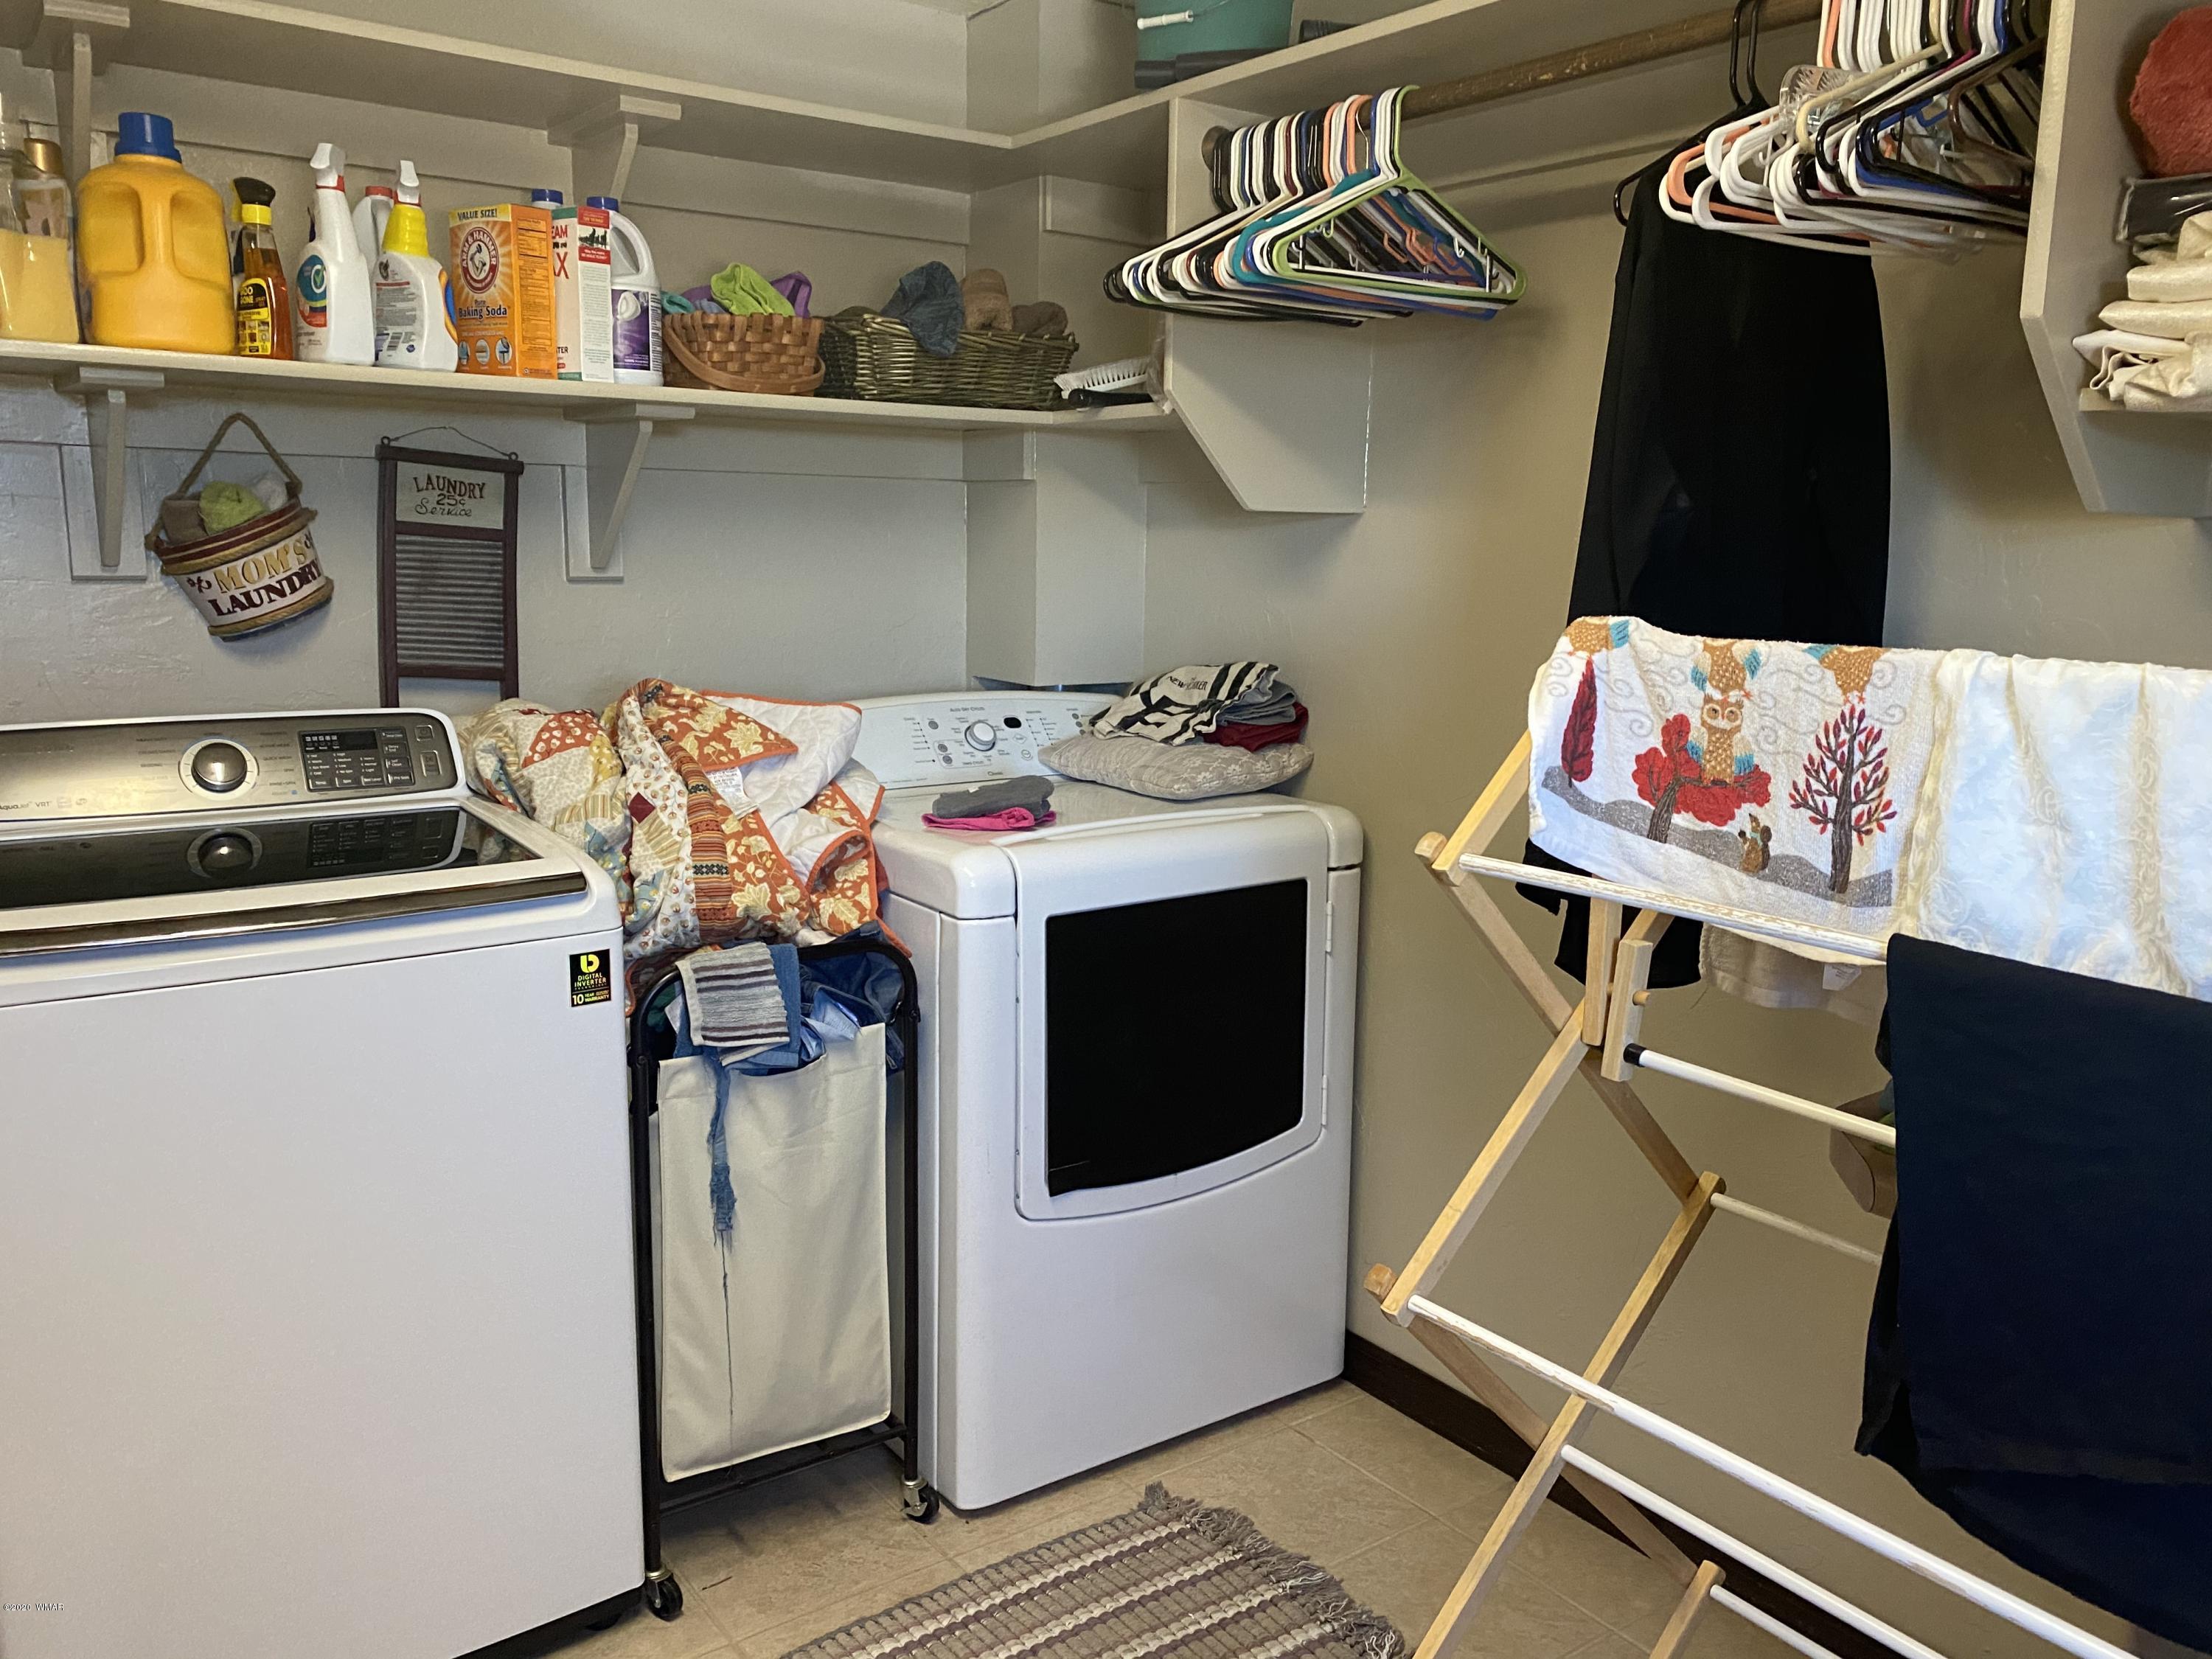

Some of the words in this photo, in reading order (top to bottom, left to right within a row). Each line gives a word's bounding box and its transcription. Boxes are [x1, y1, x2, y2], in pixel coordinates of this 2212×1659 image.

[458, 211, 479, 220] VALUE
[481, 209, 498, 218] SIZE!
[552, 225, 568, 240] EAM
[473, 230, 497, 265] HAMMER
[459, 306, 483, 319] Baking
[486, 305, 507, 317] Soda
[413, 473, 486, 498] LAUNDRY
[414, 497, 472, 517] Service
[213, 537, 308, 594] MOM'S
[208, 558, 321, 616] LAUNDRY
[574, 977, 607, 988] INVERTER
[577, 972, 603, 981] DIGITAL
[572, 994, 585, 1005] 10
